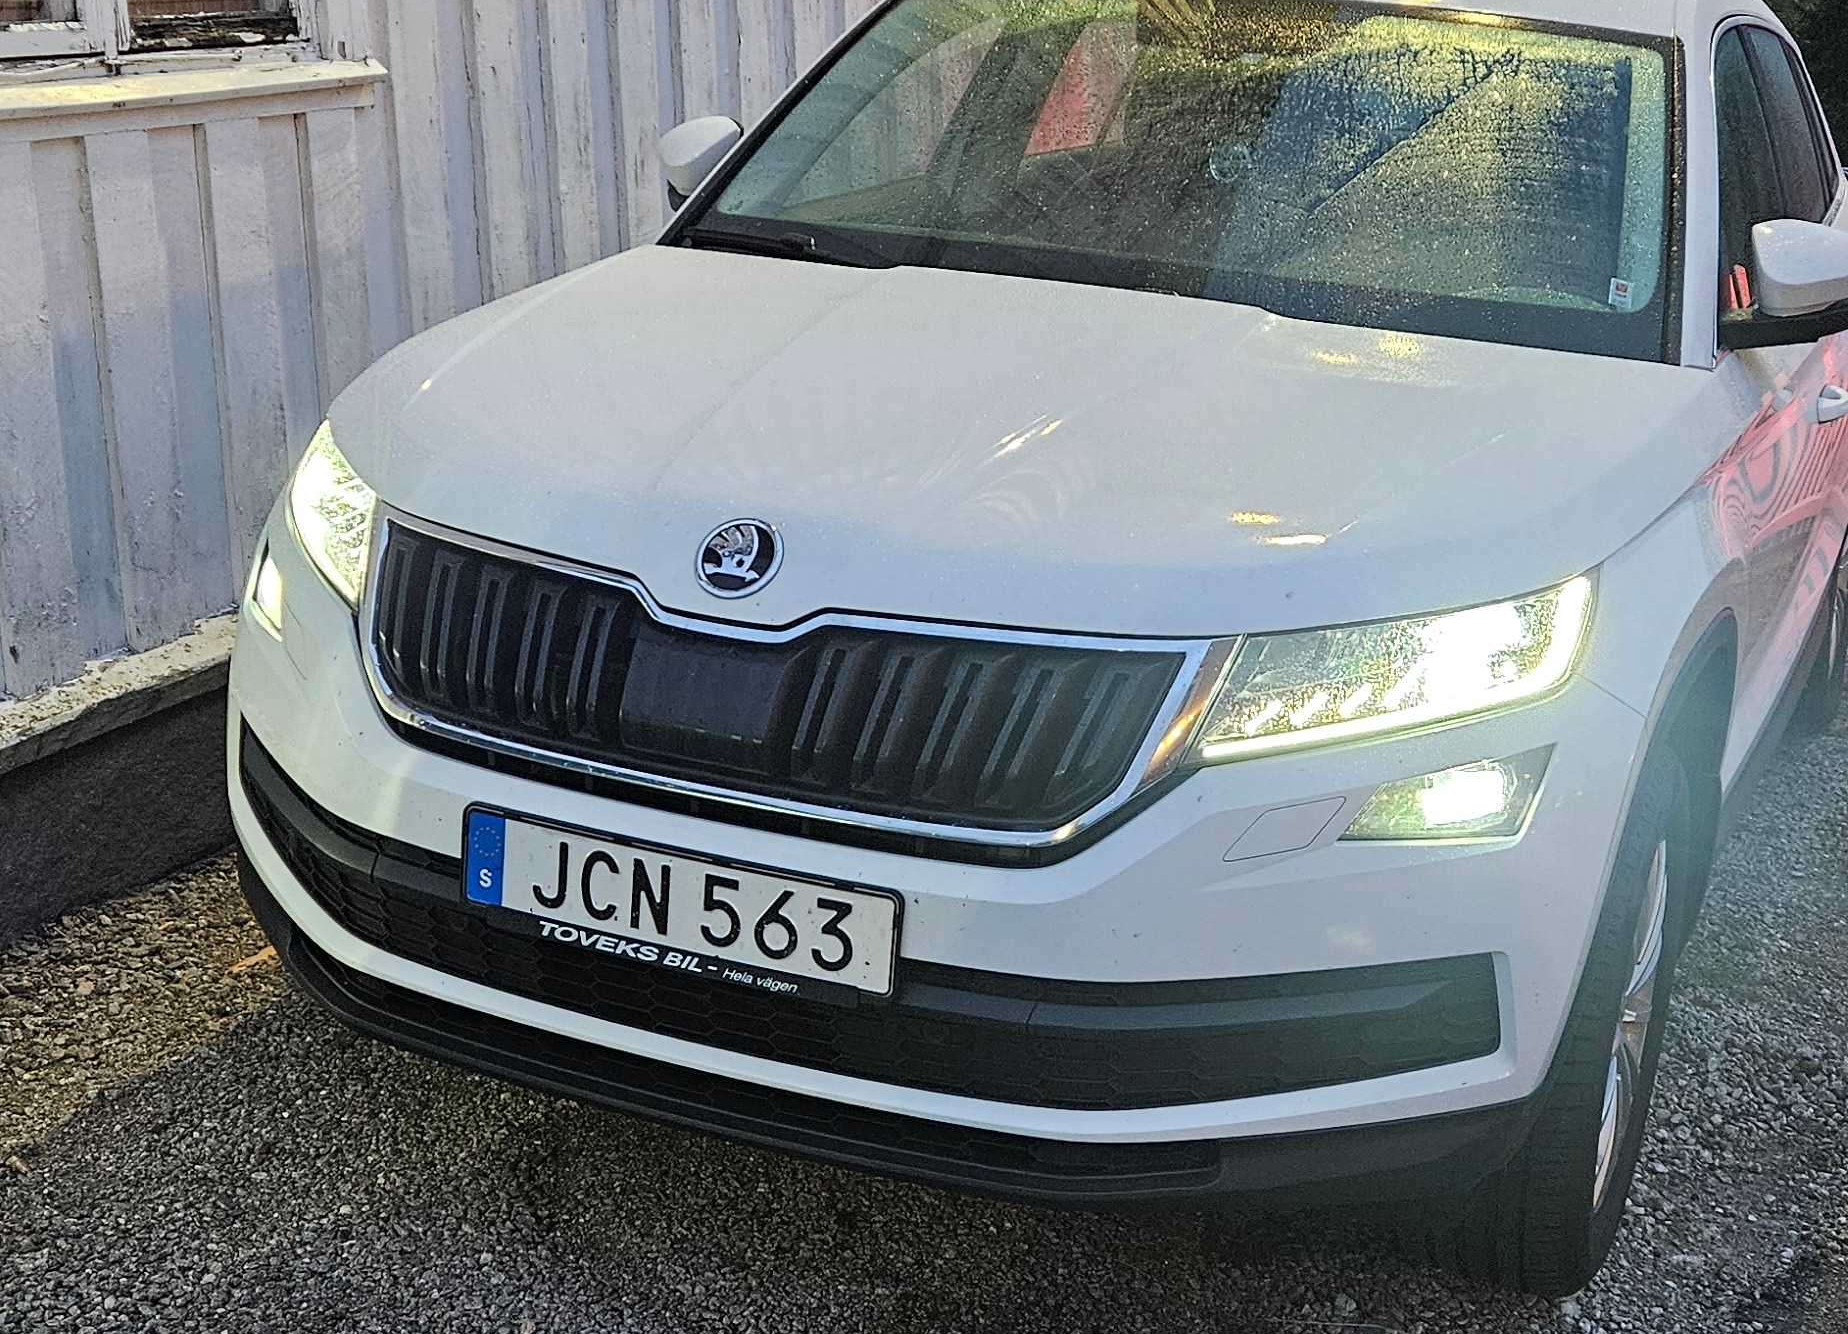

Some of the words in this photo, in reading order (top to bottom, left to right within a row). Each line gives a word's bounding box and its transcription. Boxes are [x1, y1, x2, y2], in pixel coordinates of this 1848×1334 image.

[479, 868, 493, 888] S
[532, 841, 671, 936] JCN
[700, 873, 854, 971] 563
[539, 920, 659, 962] TOVEKS
[662, 951, 703, 973] BIL
[722, 967, 753, 985] Hela
[756, 976, 799, 994] vägen
